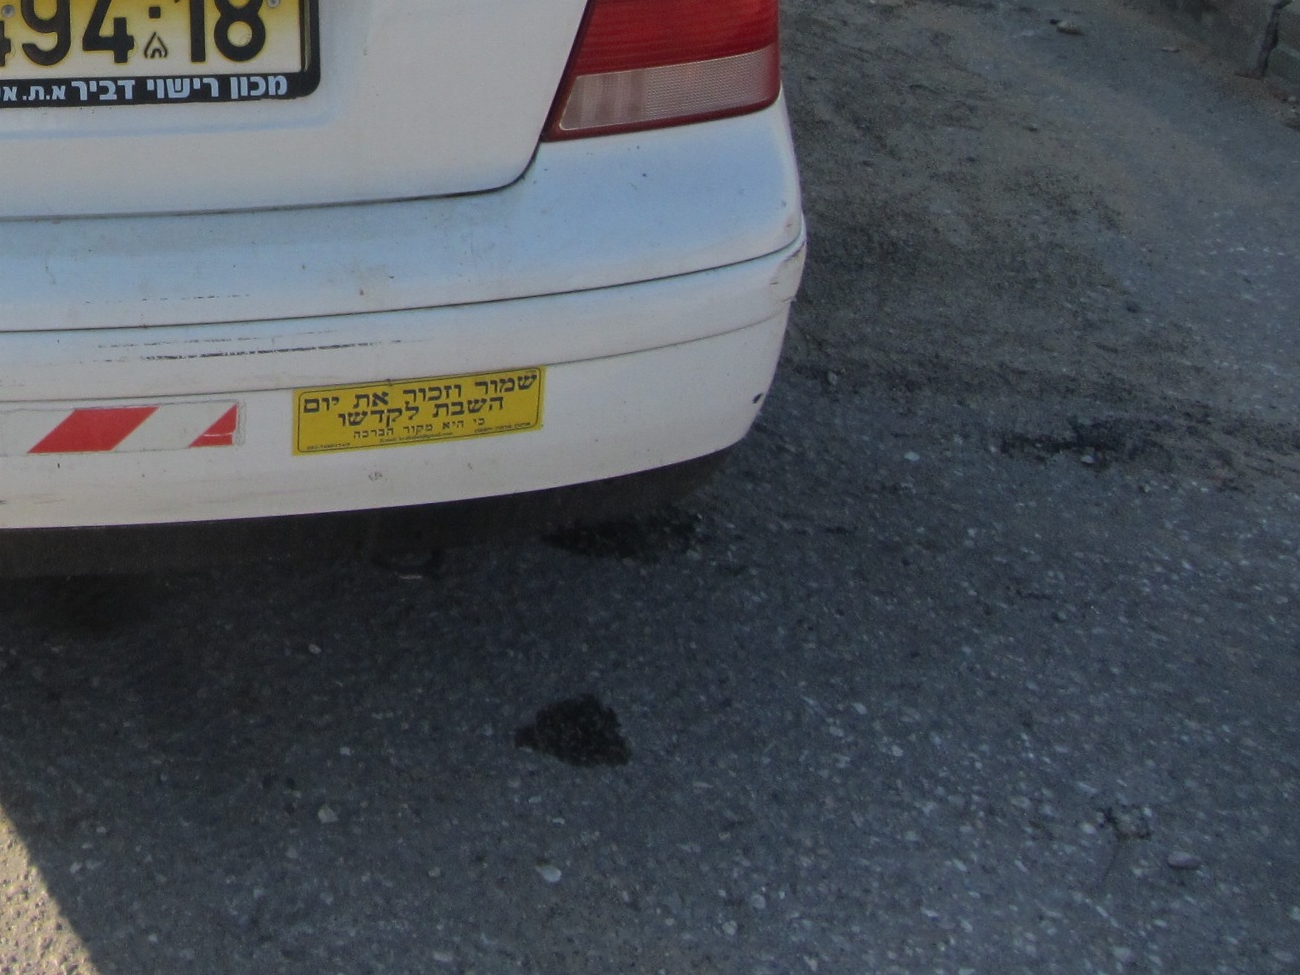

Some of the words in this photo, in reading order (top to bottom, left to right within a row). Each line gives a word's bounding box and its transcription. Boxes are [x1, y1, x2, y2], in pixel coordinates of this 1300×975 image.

[71, 80, 135, 101] דביר
[146, 77, 219, 100] רישוי
[230, 75, 287, 99] מכון
[403, 384, 462, 403] וזכור
[475, 374, 537, 395] שמור
[304, 396, 340, 413] יום
[353, 391, 389, 409] את
[432, 396, 504, 418] השבת
[338, 401, 420, 427] לקדשו
[473, 418, 485, 426] כי
[353, 427, 394, 439] הברכה
[403, 424, 433, 435] מקור
[443, 420, 464, 430] היא
